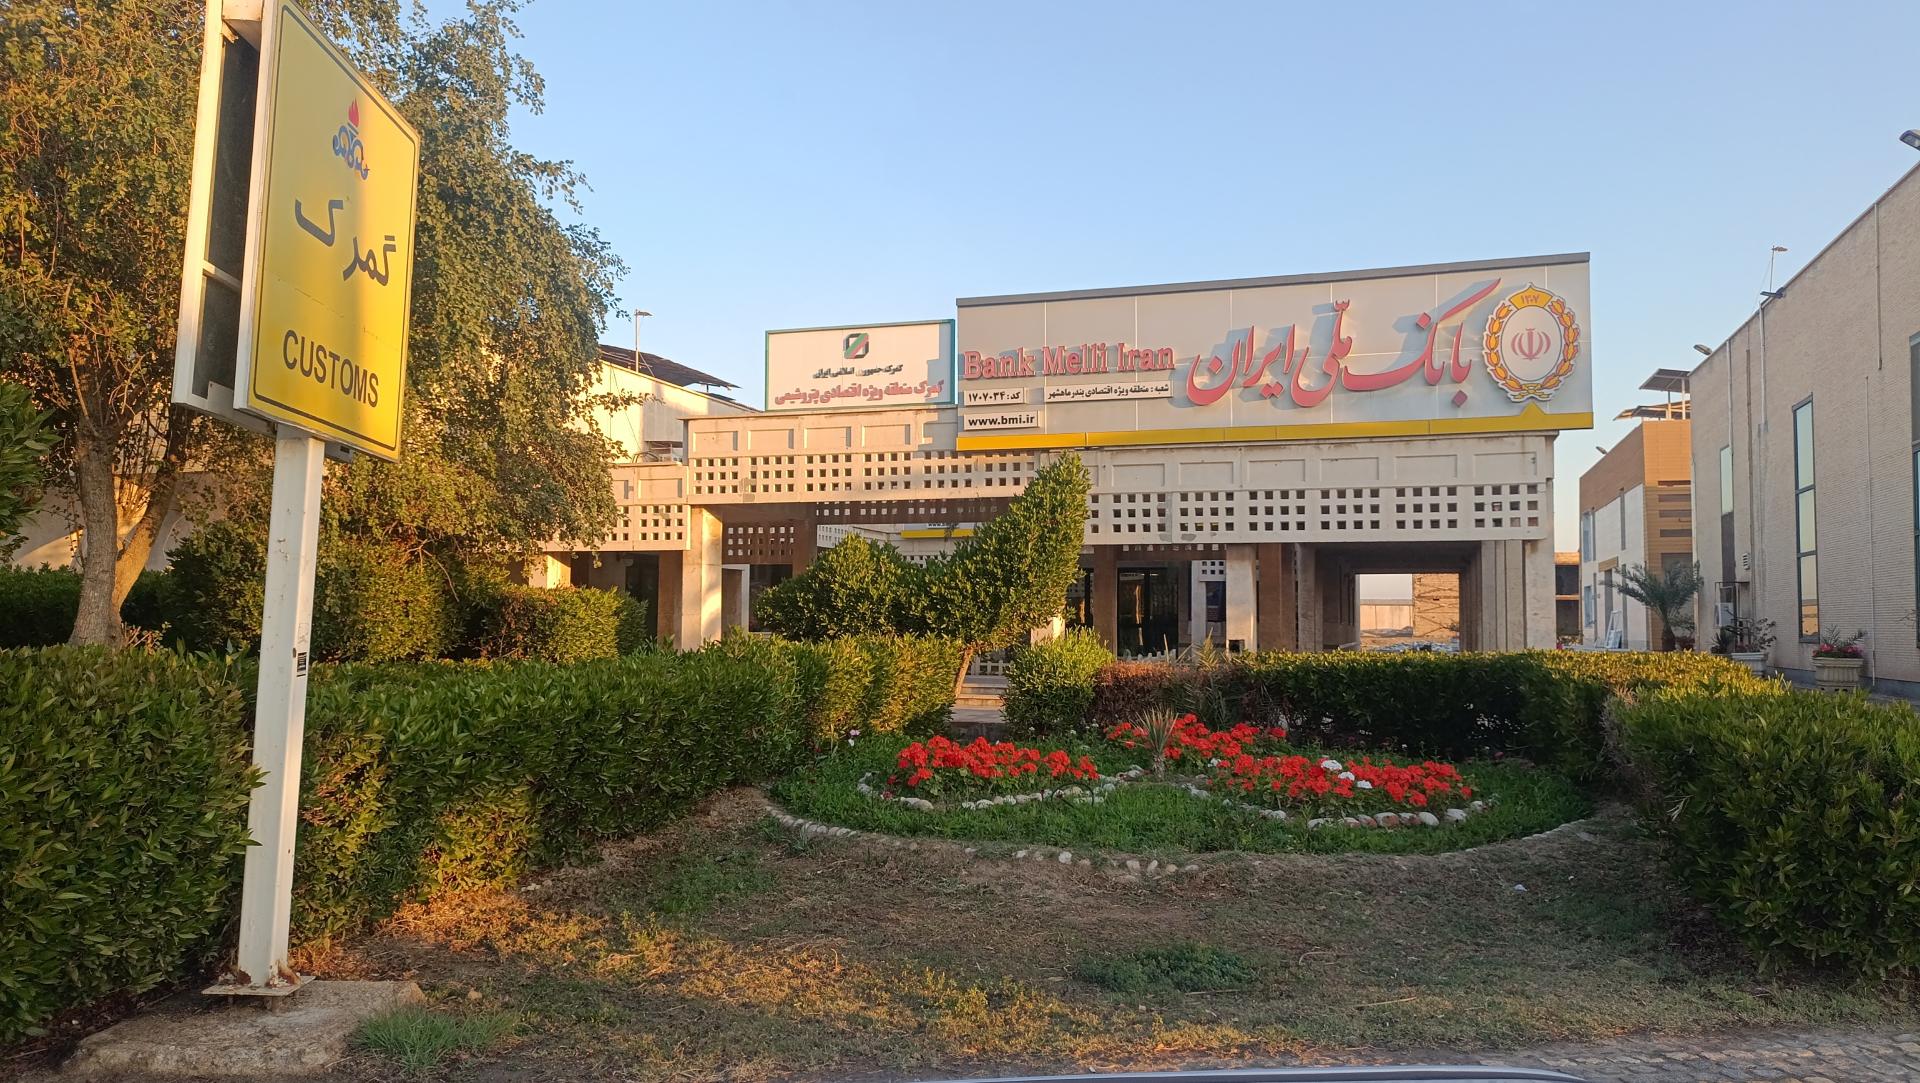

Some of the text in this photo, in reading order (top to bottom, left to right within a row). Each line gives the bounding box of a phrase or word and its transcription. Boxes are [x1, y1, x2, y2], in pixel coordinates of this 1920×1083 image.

[294, 199, 397, 286] گمرک
[1342, 278, 1501, 407] بانک
[283, 329, 379, 408] CUSTOMS
[963, 342, 1176, 380] Bank Melli Iran
[1186, 324, 1295, 406] ایران
[813, 368, 831, 379] ایران
[775, 379, 945, 405] گمرک منطقه ویژه اقتصادی پتروشیمی
[968, 391, 1005, 402] ۱۷۰۷۰۳۴
[1085, 385, 1112, 397] اقتصادی
[1113, 387, 1129, 396] ویژه
[1129, 385, 1149, 393] منطقه
[968, 415, 1035, 427] www.bmi.ir
